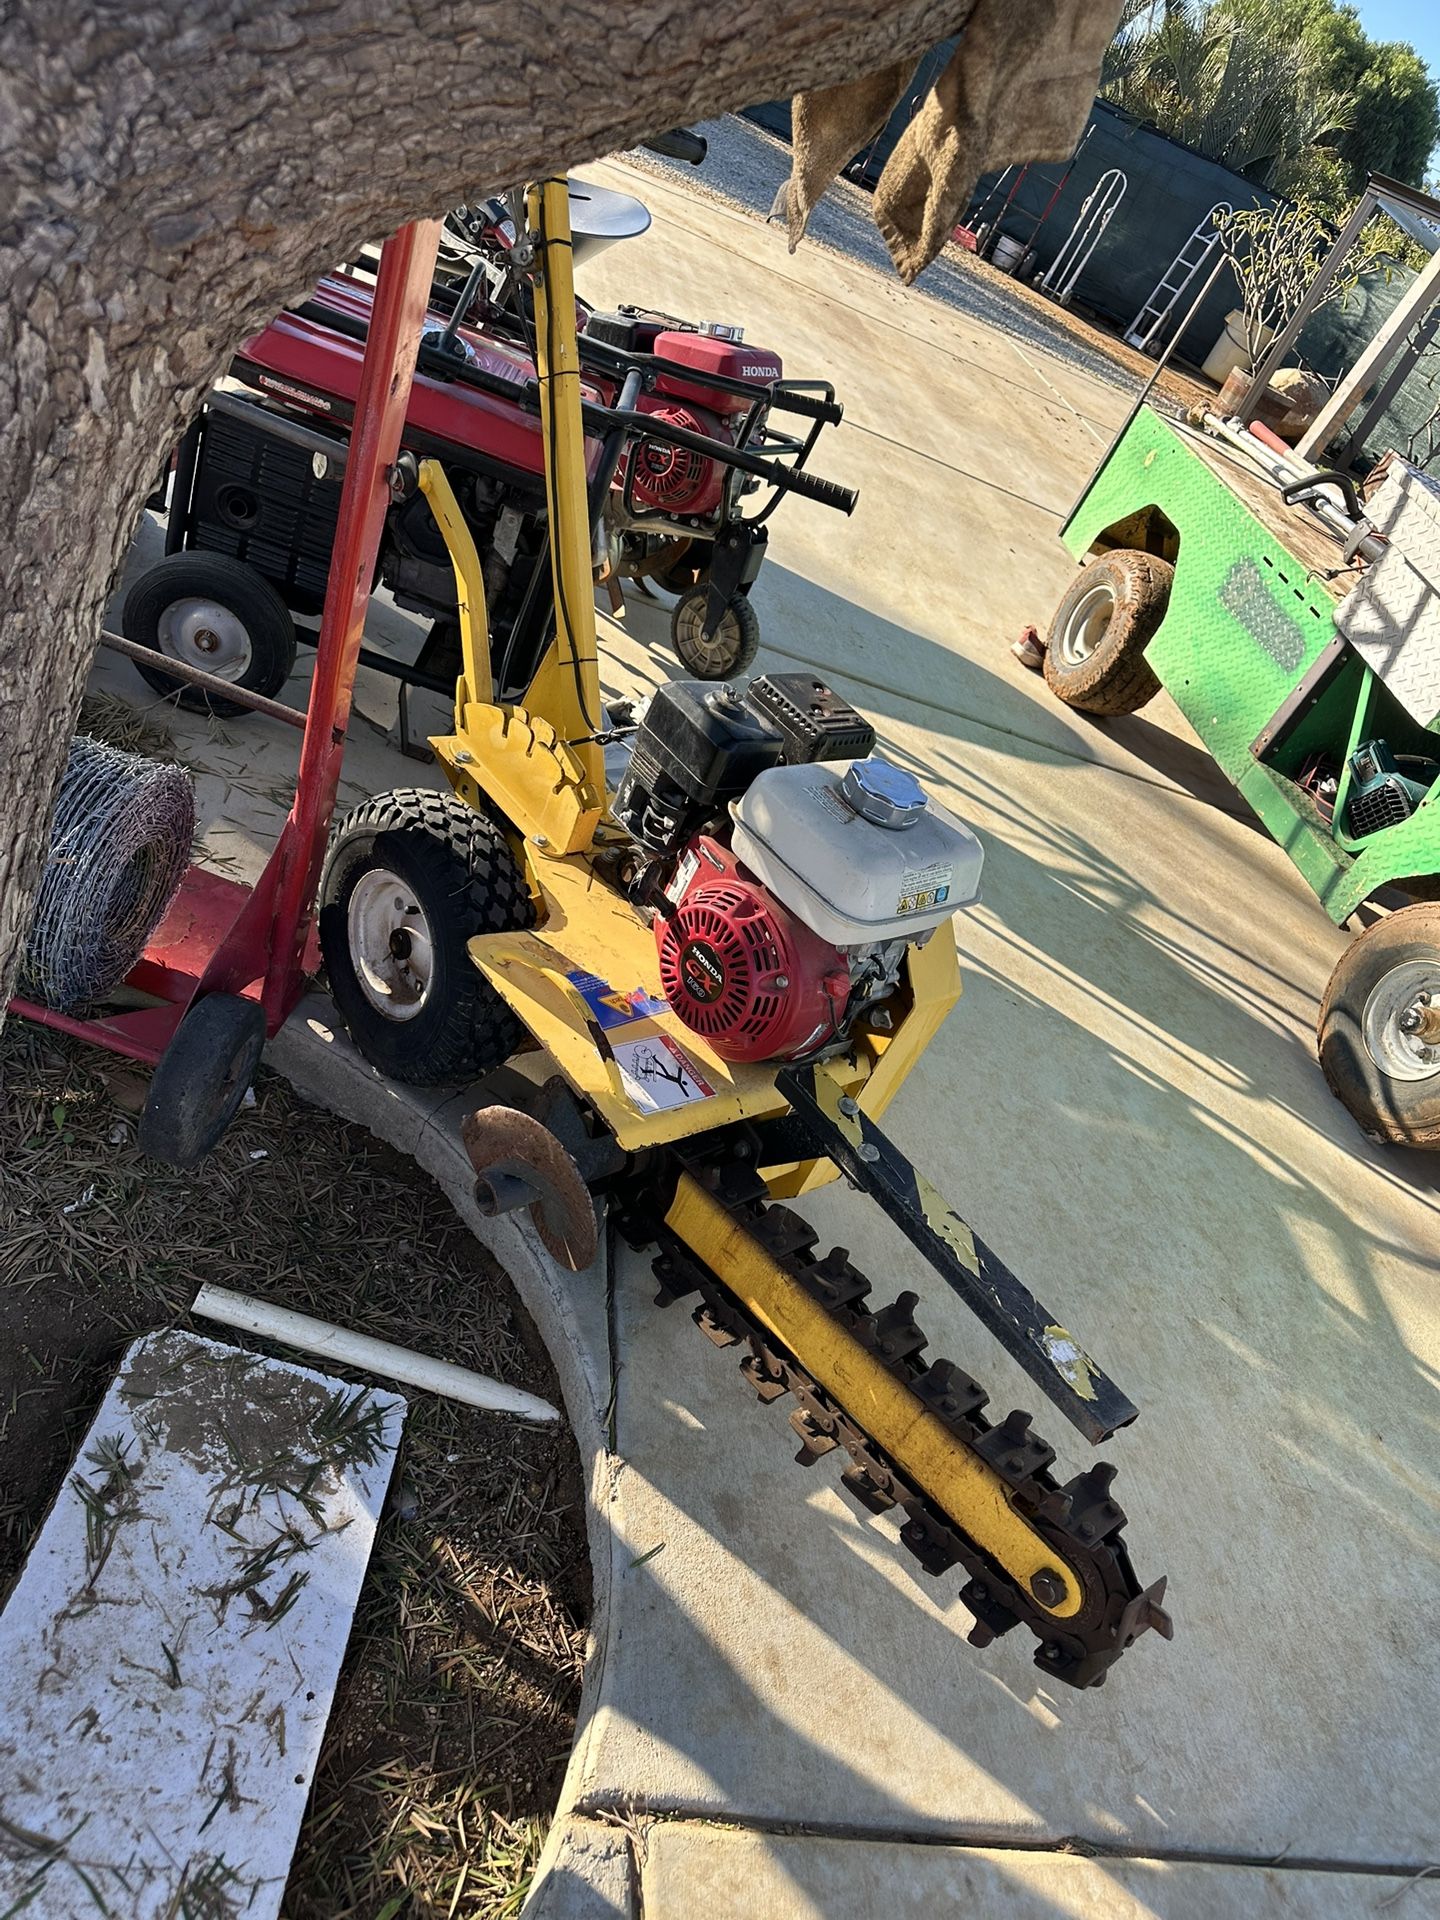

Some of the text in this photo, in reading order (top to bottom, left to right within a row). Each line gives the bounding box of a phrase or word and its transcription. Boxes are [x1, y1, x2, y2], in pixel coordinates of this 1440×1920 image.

[742, 366, 779, 378] HONDA
[647, 451, 669, 466] GX
[648, 444, 671, 455] HONDA
[685, 959, 718, 995] GX
[691, 946, 723, 984] HONDA
[676, 1053, 706, 1087] DANGER
